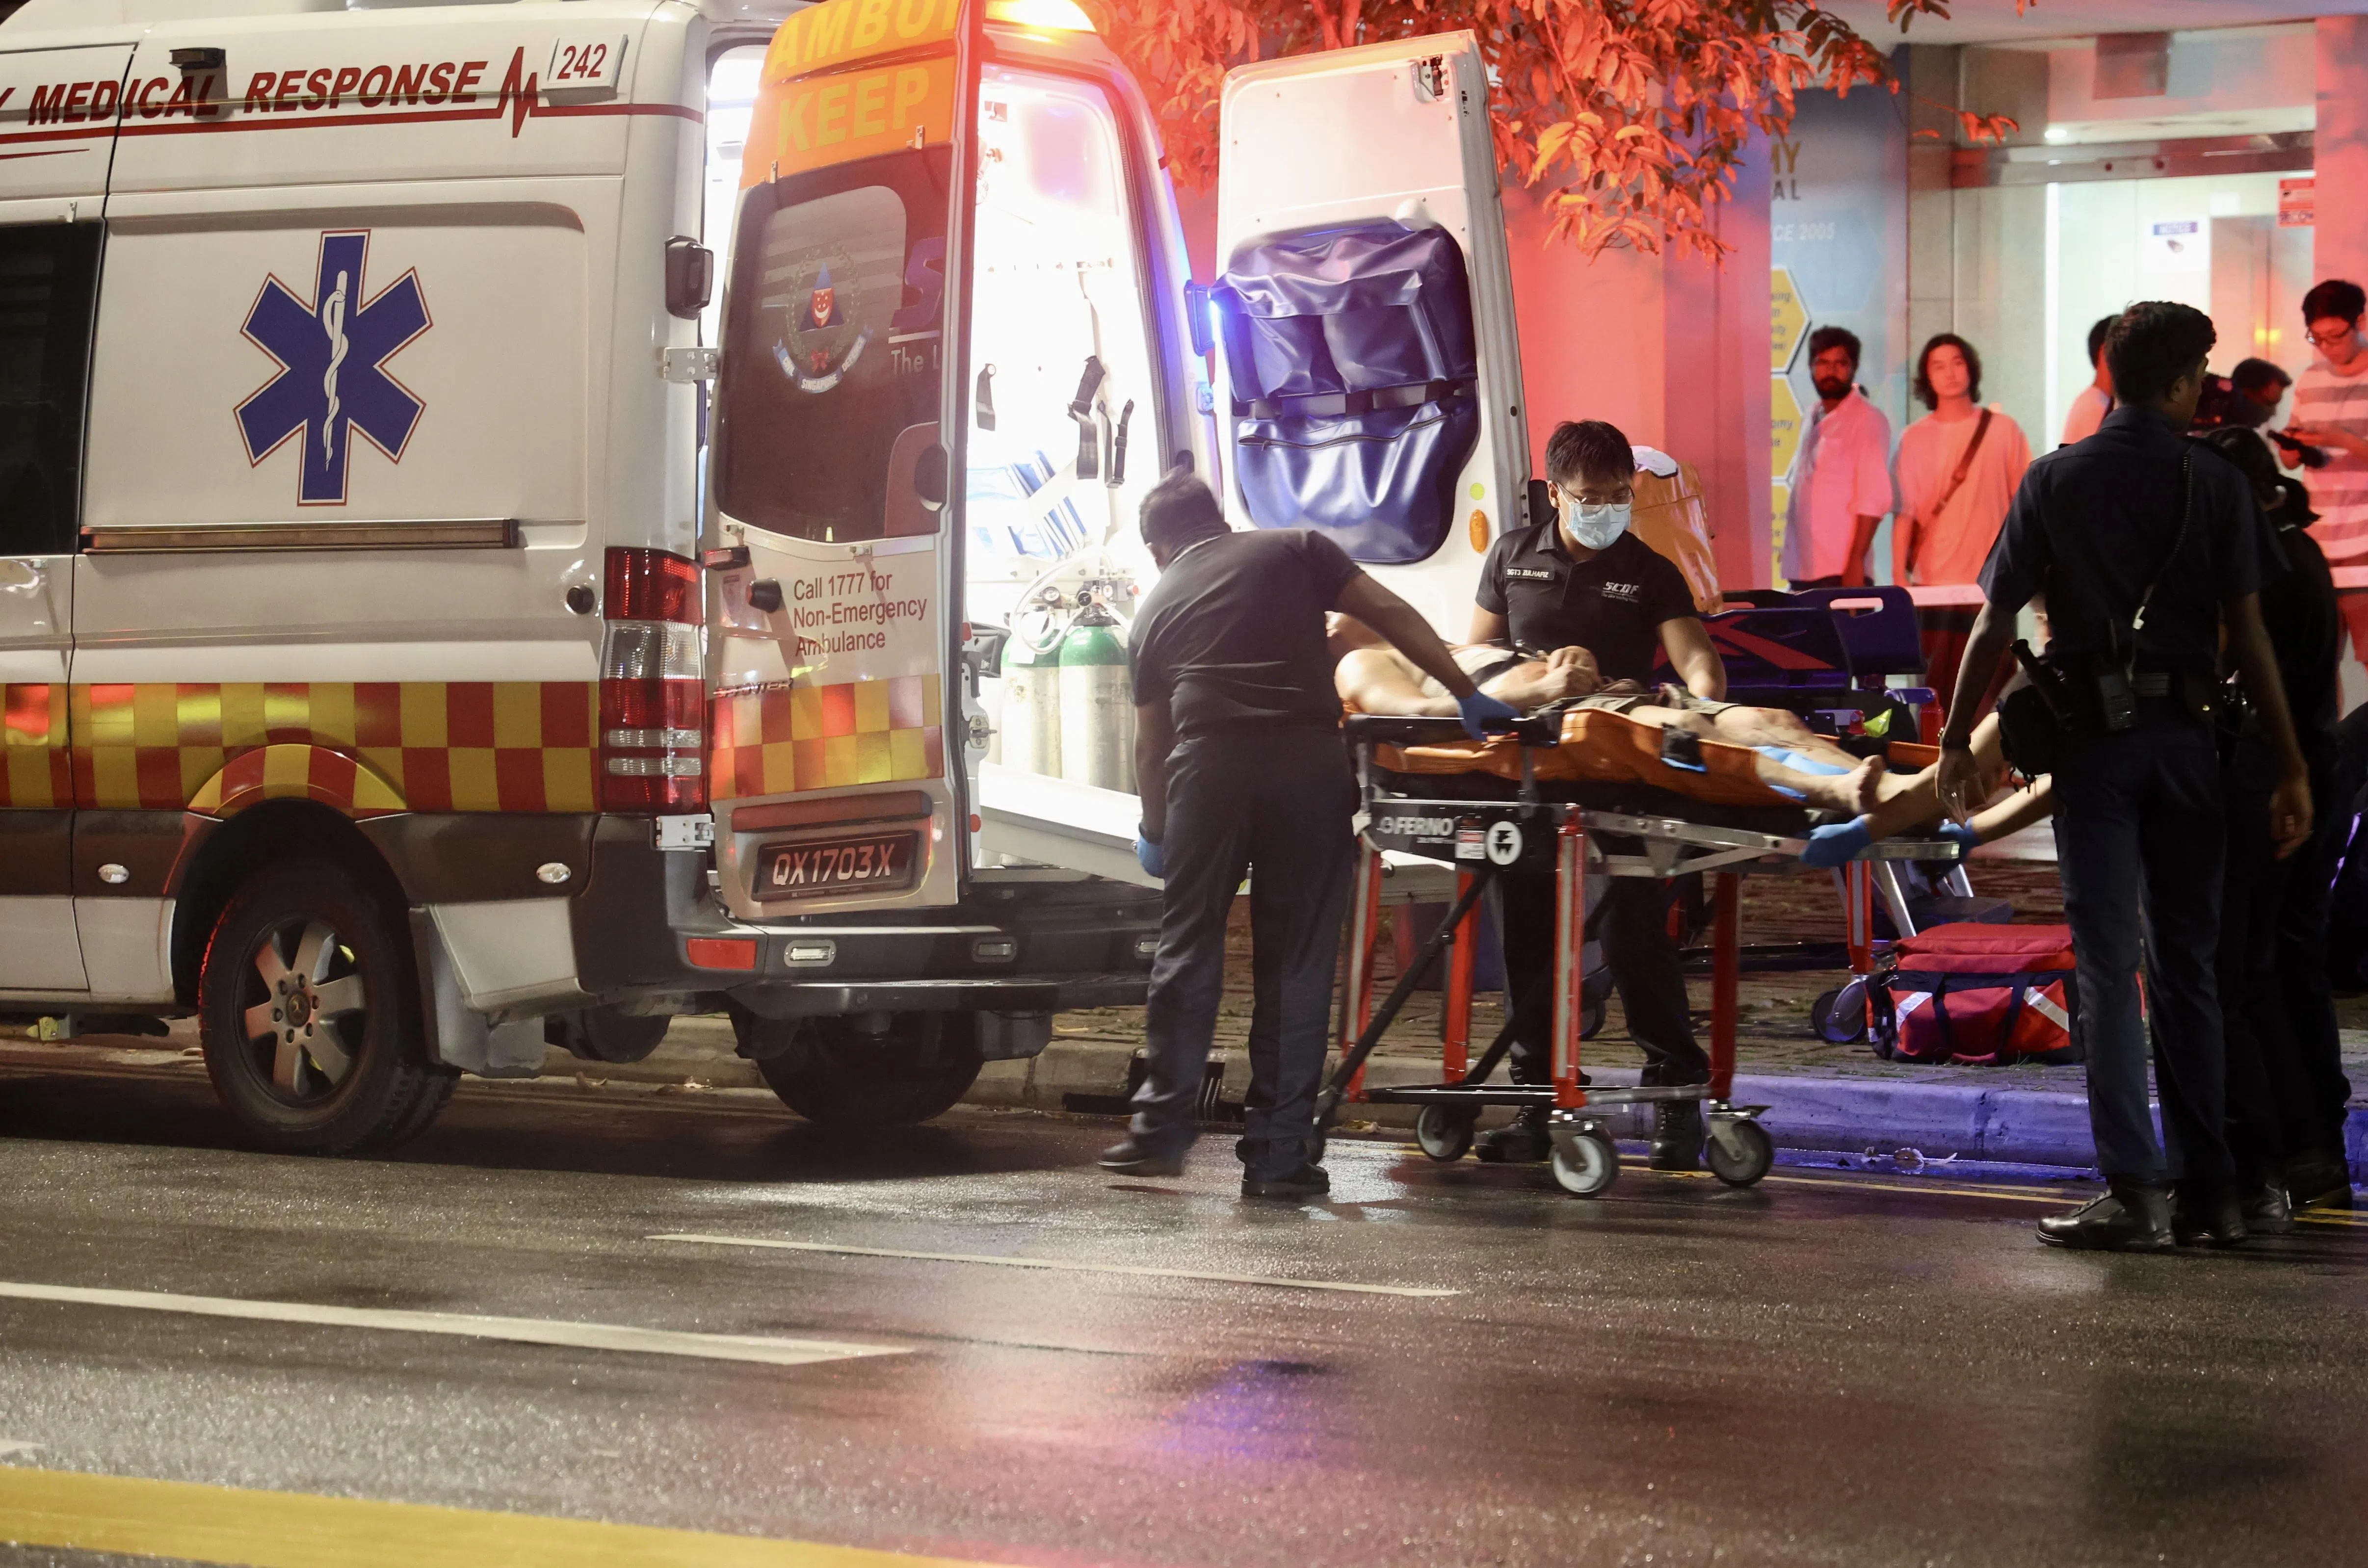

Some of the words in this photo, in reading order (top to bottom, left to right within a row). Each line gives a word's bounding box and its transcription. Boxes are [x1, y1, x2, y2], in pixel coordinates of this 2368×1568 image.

[557, 43, 607, 80] 242
[27, 75, 221, 126] MEDICAL
[243, 60, 489, 114] RESPONSE
[776, 67, 929, 158] KEEP
[891, 346, 924, 377] The
[801, 373, 838, 391] SINGAPORE
[794, 579, 822, 601] Call
[828, 572, 865, 597] 1777
[870, 570, 893, 592] for
[1603, 581, 1639, 594] SCDF
[794, 598, 927, 629] Non-Emergency
[795, 631, 886, 657] Ambulance
[772, 843, 895, 886] QX1703X
